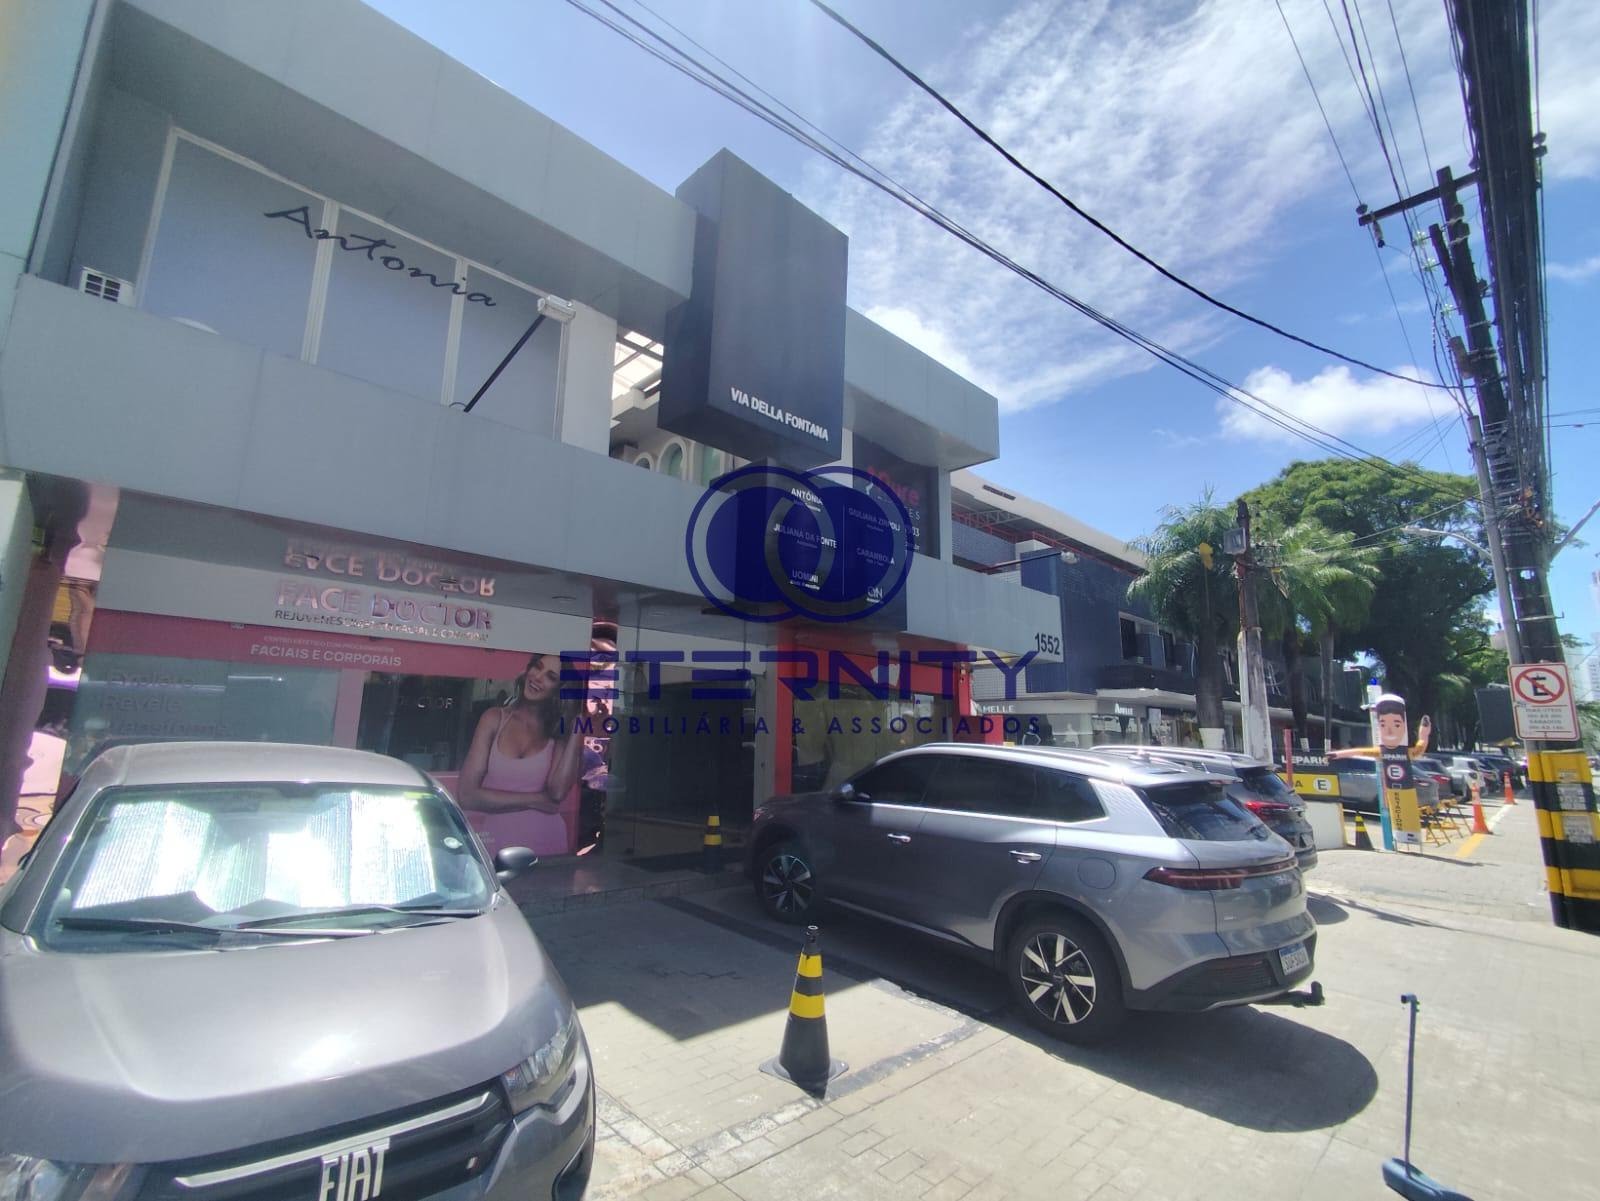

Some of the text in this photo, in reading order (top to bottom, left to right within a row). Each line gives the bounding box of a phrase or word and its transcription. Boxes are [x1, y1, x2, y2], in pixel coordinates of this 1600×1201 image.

[731, 387, 829, 441] VIA DELLA FONTANA
[278, 580, 493, 630] FACE DOCTOR
[250, 644, 402, 667] FACIAIS E CORPORAIS
[1035, 632, 1061, 655] 1552
[319, 1137, 390, 1201] FIAT
